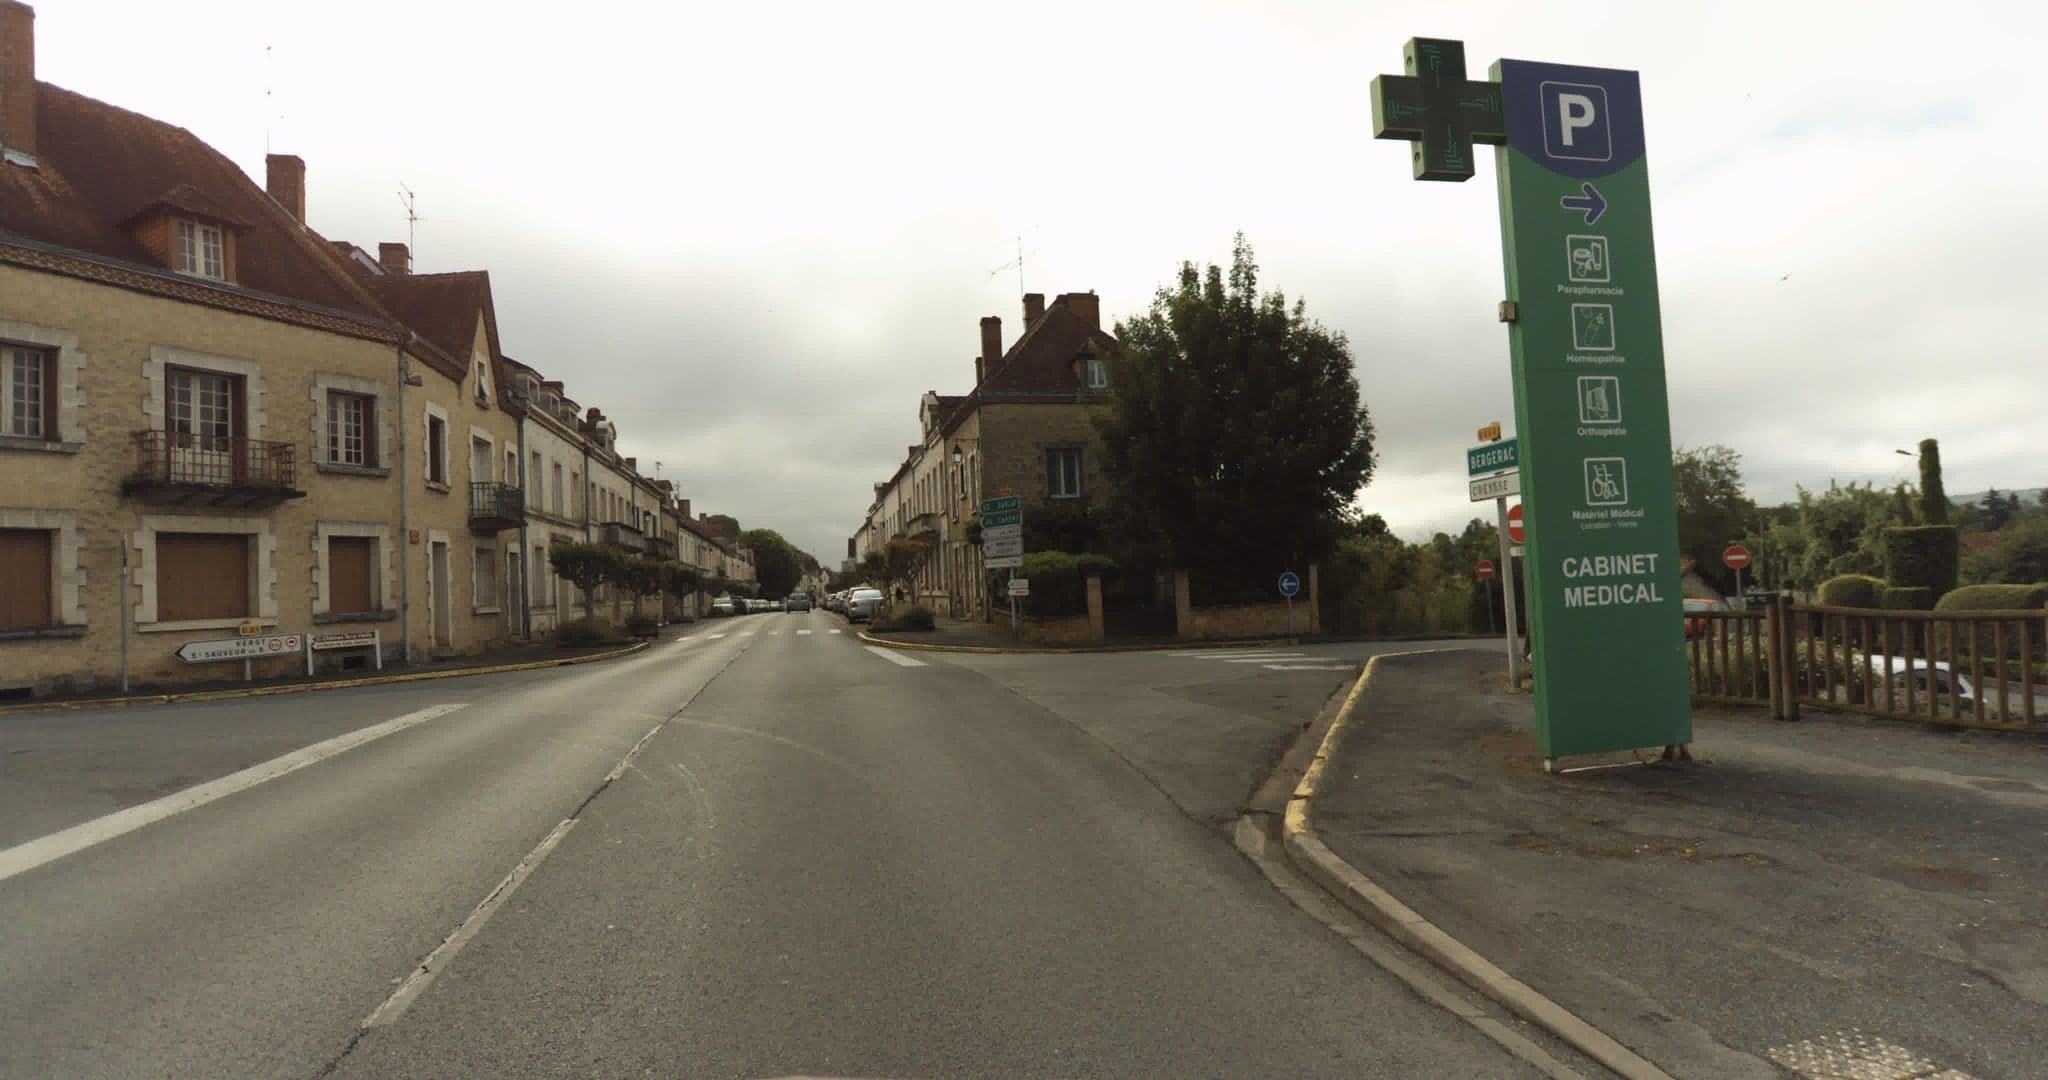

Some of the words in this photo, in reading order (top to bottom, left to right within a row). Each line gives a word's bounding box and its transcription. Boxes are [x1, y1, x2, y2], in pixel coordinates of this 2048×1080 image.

[1558, 92, 1595, 146] P
[1557, 284, 1625, 298] Parapharmacie
[1471, 446, 1515, 469] BERGERAC
[1472, 480, 1508, 496] CREYSSE
[1562, 553, 1659, 578] CABINET
[1564, 582, 1664, 609] MEDICAL
[235, 638, 265, 648] VERGT
